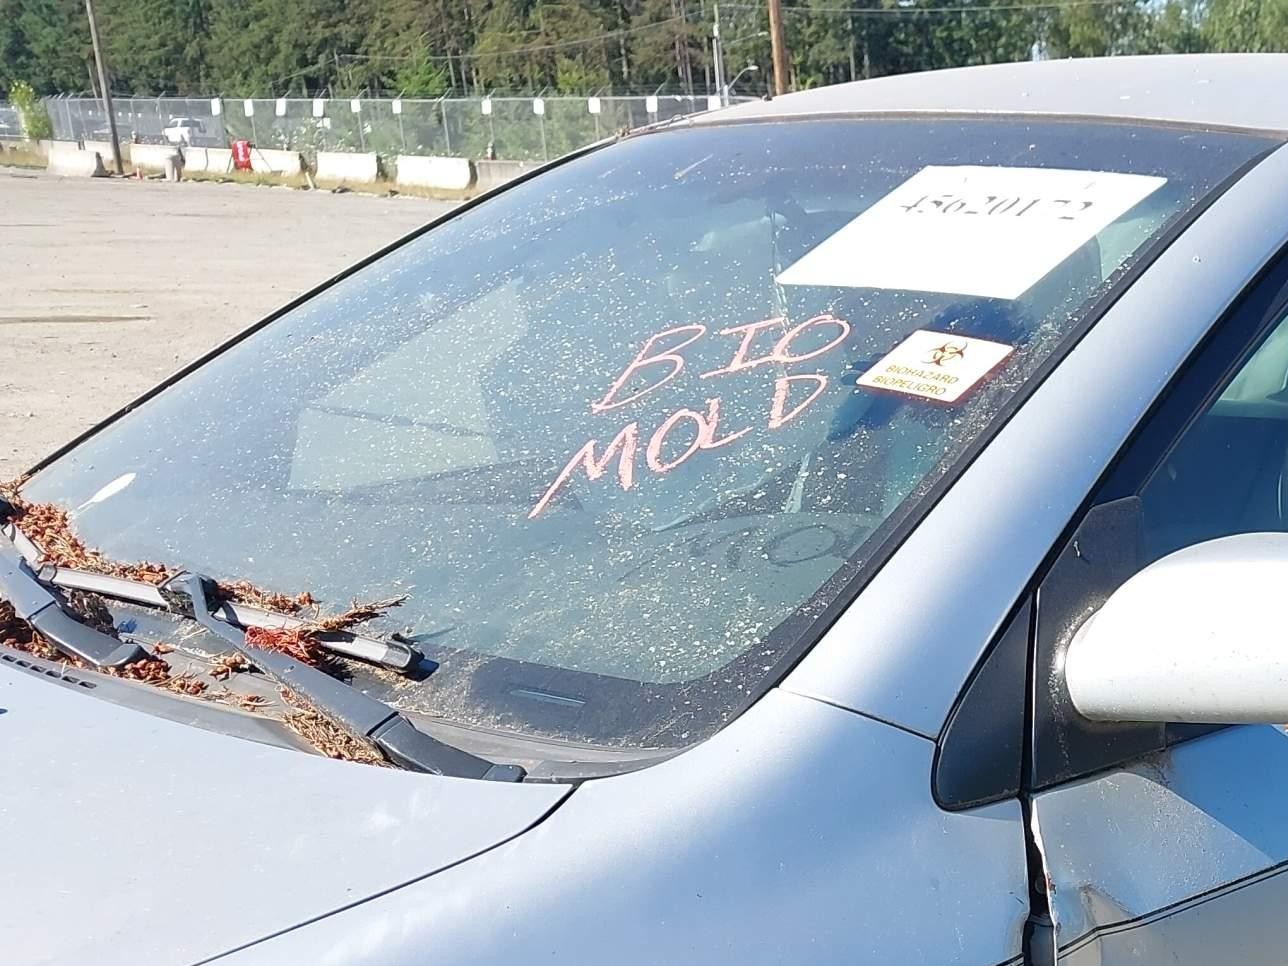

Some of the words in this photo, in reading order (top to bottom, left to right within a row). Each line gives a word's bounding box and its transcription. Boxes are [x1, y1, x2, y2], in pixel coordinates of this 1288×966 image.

[591, 314, 851, 414] BIO
[872, 375, 947, 396] BIOPELIGRO
[885, 364, 960, 385] BIOHAZARD
[528, 373, 828, 519] MOLD
